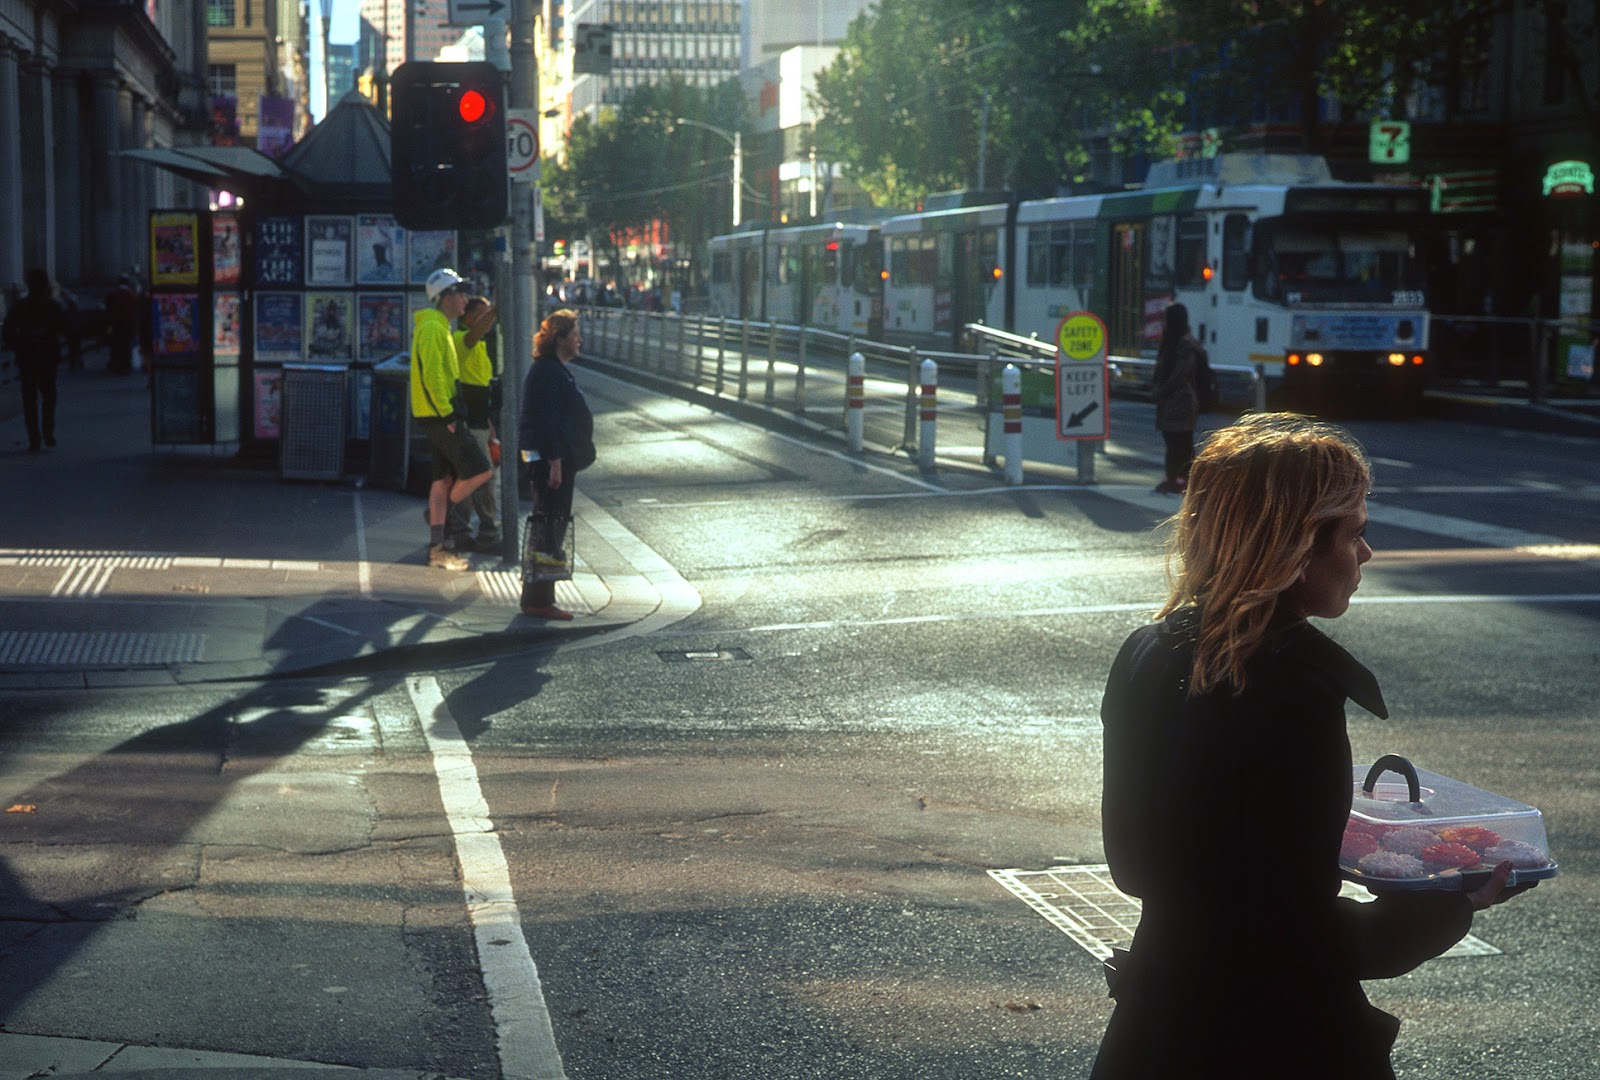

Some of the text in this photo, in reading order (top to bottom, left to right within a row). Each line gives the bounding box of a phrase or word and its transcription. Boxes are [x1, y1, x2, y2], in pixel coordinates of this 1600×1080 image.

[1064, 325, 1097, 338] SAFETY
[1069, 340, 1093, 353] ZONE
[1066, 371, 1097, 382] KEEP
[1066, 384, 1096, 396] LEFT
